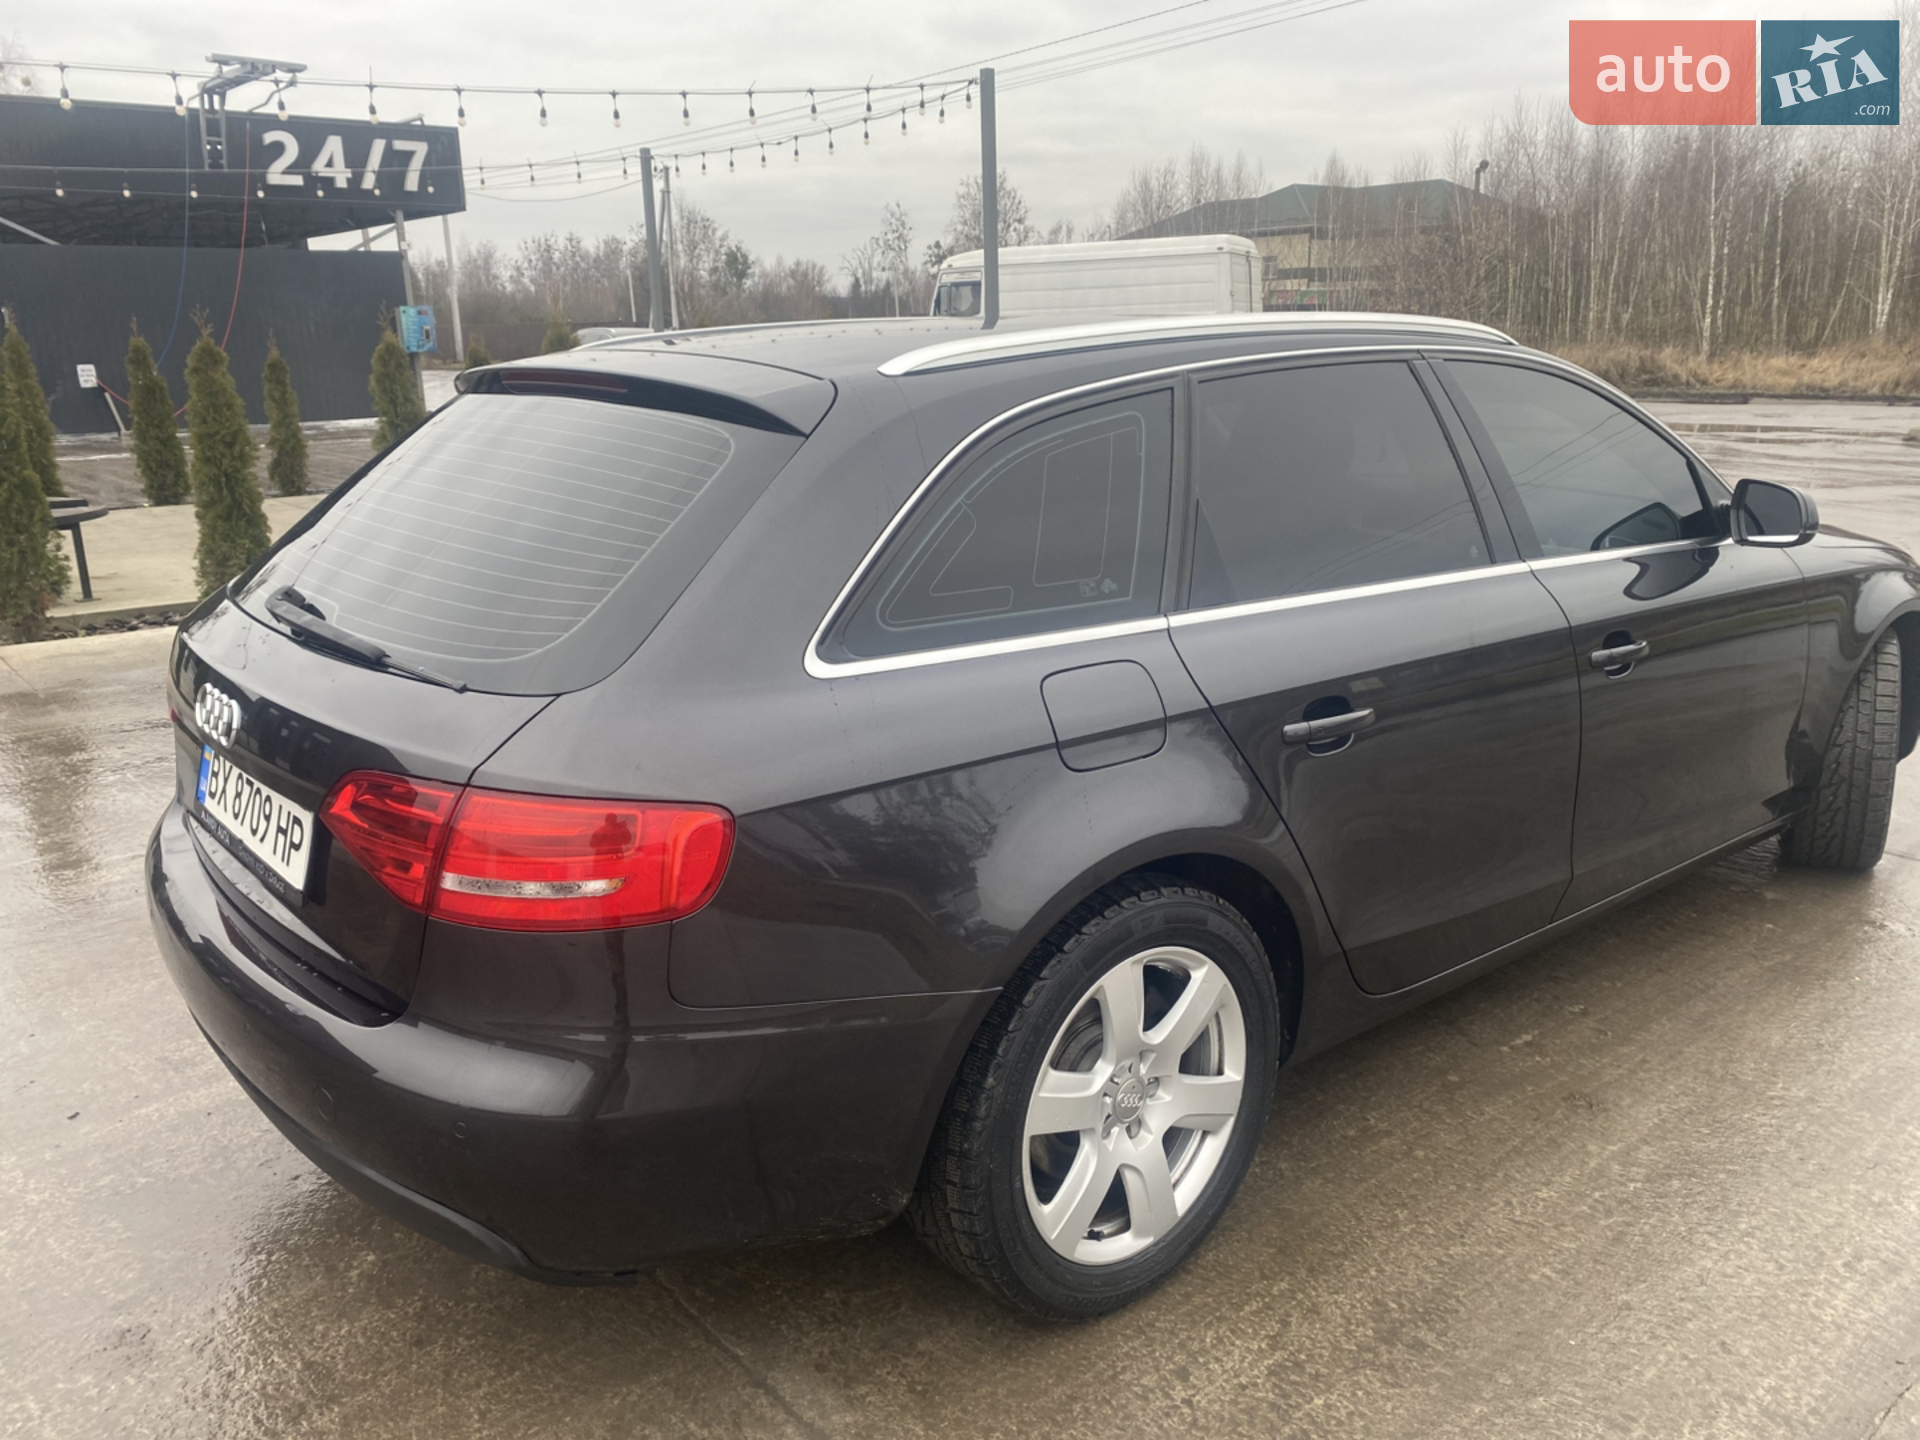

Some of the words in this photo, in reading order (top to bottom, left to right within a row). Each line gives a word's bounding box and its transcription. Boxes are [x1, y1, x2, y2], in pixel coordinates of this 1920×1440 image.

[262, 129, 429, 192] 24/7
[207, 754, 233, 813] BX
[232, 771, 273, 844] 8709
[272, 804, 304, 867] HP
